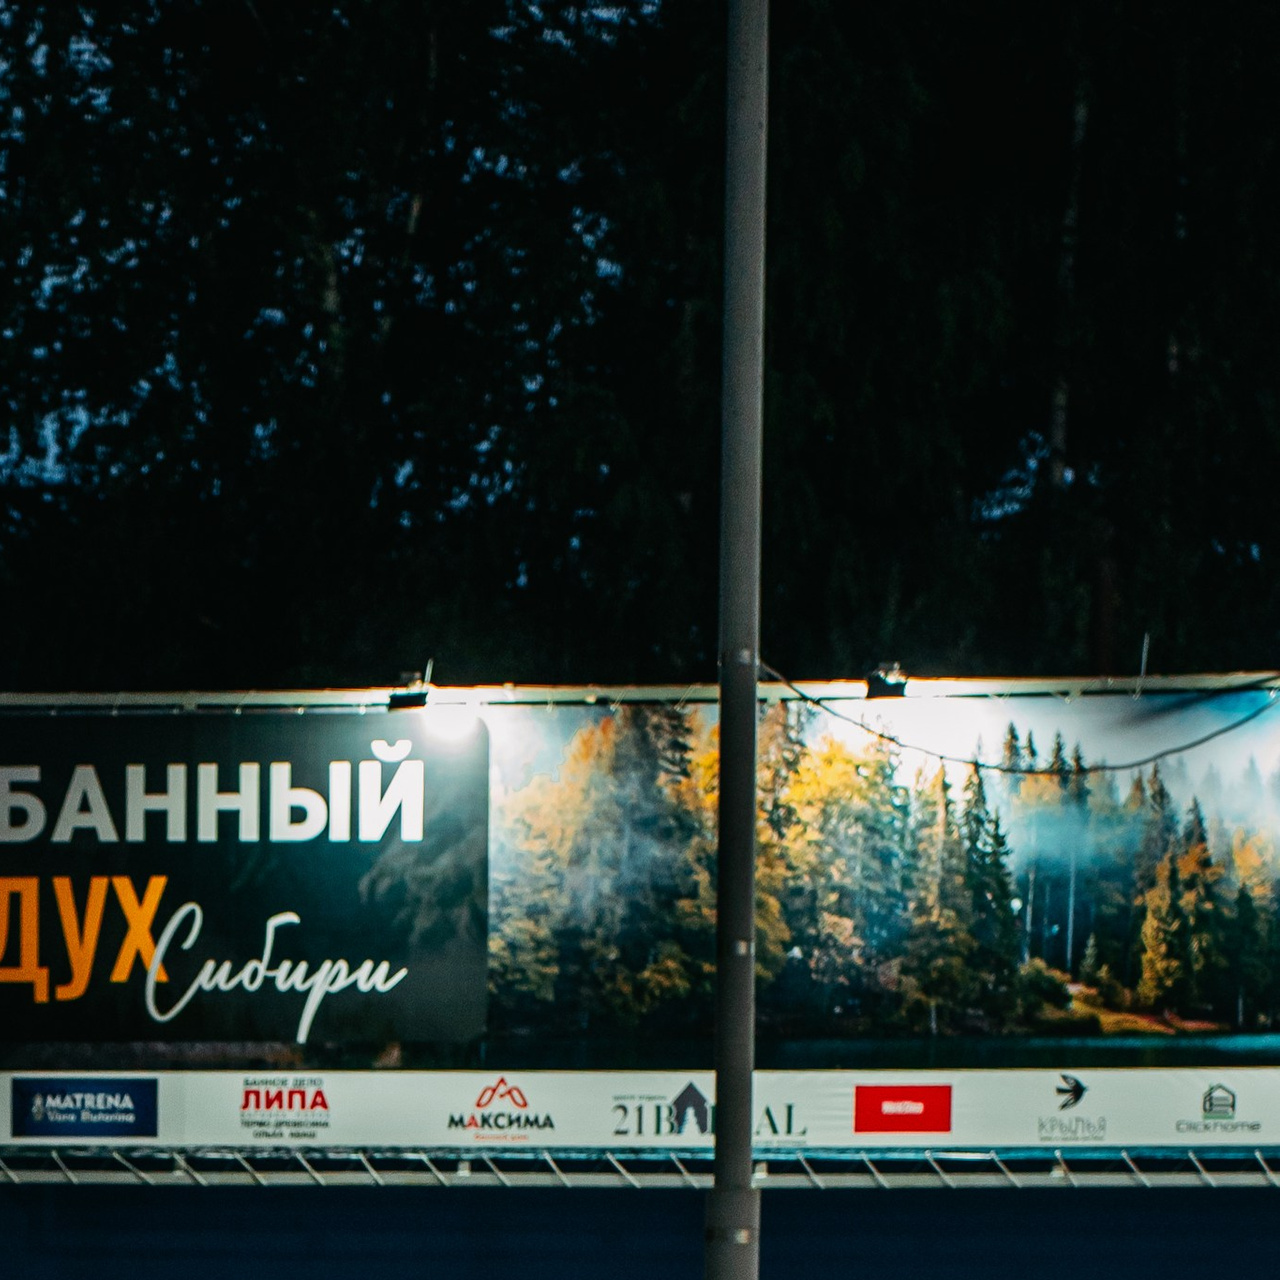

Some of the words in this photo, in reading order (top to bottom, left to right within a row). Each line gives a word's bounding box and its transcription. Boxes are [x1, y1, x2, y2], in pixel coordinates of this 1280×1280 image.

[145, 902, 409, 1045] Сибири
[45, 1093, 135, 1109] MATRENA
[241, 1089, 329, 1110] ЛИПА
[448, 1113, 555, 1129] МАКСИМА
